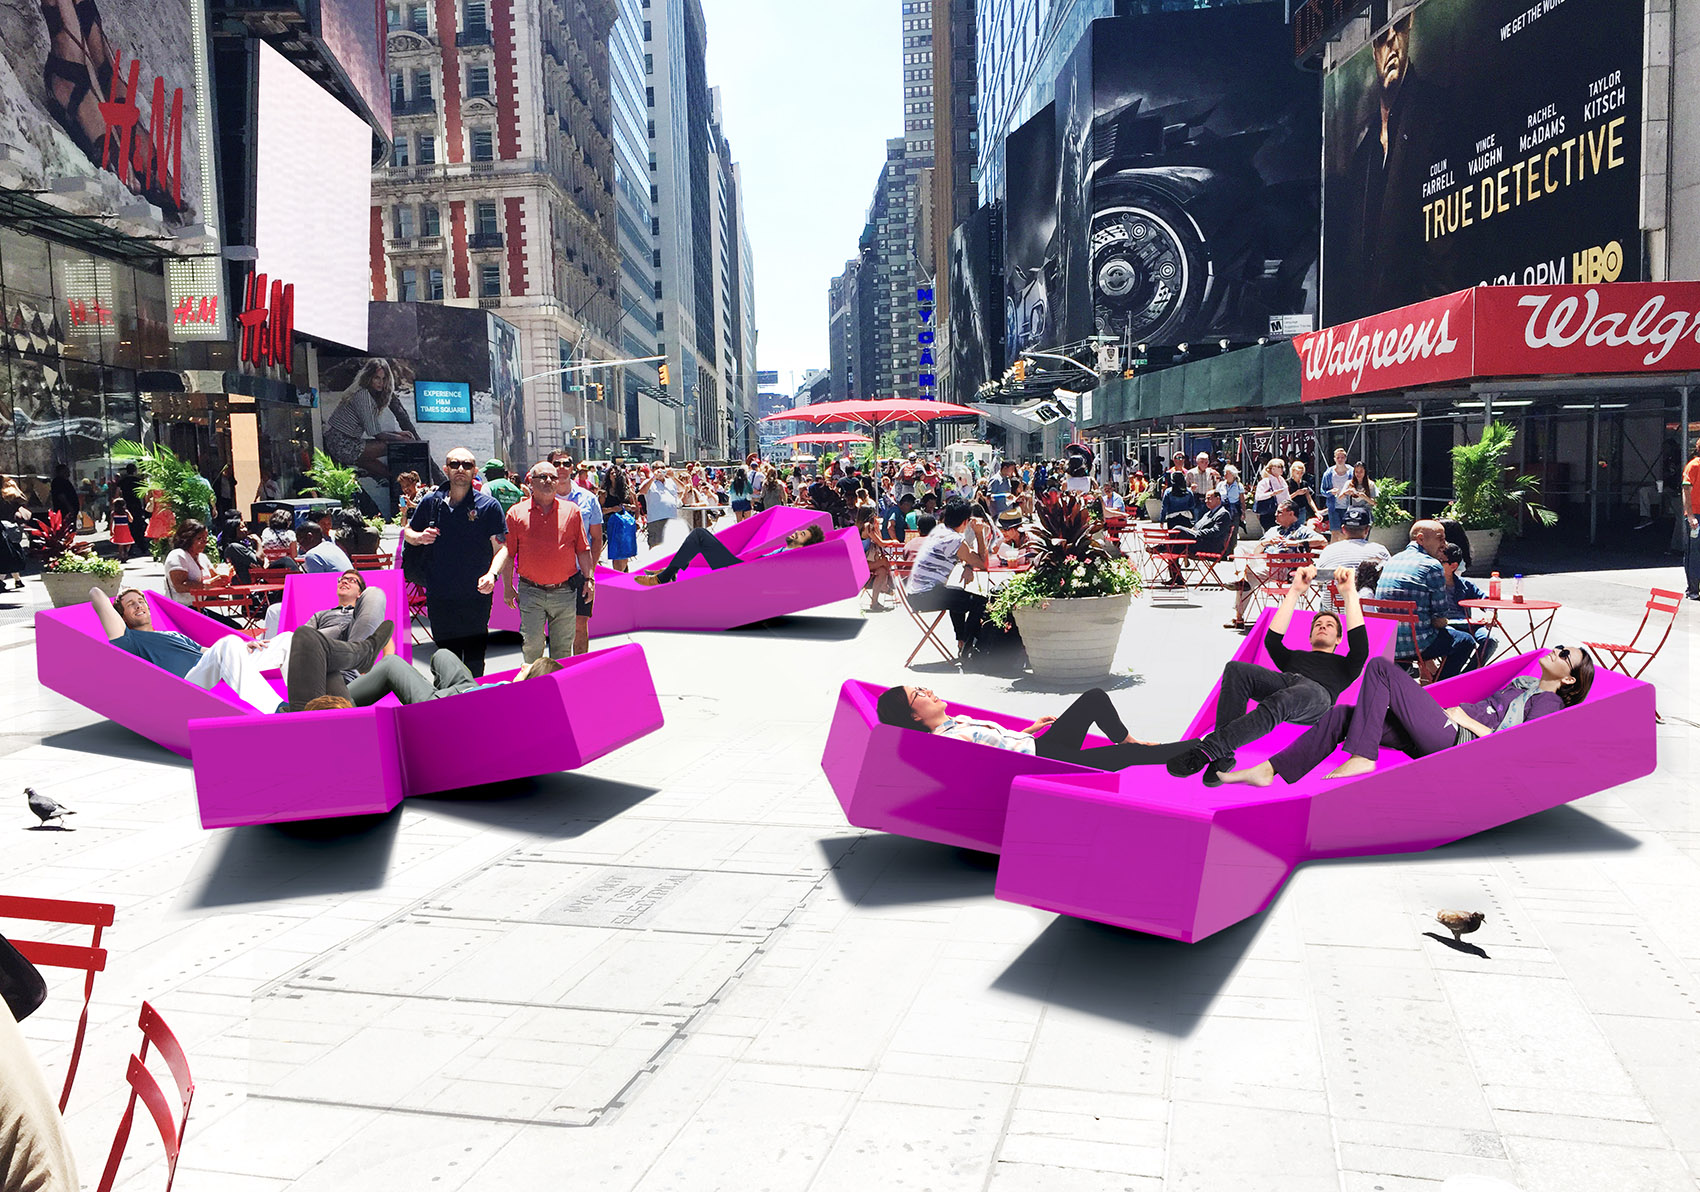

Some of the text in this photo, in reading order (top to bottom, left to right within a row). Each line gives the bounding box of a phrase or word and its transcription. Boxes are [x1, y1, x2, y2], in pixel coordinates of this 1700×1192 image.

[1500, 22, 1512, 41] WE
[1512, 12, 1527, 34] GET
[1527, 2, 1542, 24] THE
[1588, 69, 1621, 98] TAYLOR
[1527, 102, 1558, 129] RACHEL
[1583, 86, 1626, 122] KITSCH
[98, 49, 183, 209] H&M
[1475, 133, 1496, 154] VINCE
[1519, 115, 1566, 153] McADAMS
[1429, 158, 1448, 177] COLIN
[1467, 145, 1503, 177] VAUGHN
[1422, 115, 1626, 242] TRUE DETECTIVE
[1422, 170, 1456, 198] FARRELL
[1572, 240, 1624, 285] HBO
[173, 295, 218, 326] H&M
[238, 270, 295, 375] H&M
[1270, 320, 1282, 332] M
[1302, 309, 1459, 393] Walgreens
[423, 389, 462, 398] EXPERIENCE
[420, 405, 467, 414] TIMES SQUARE!
